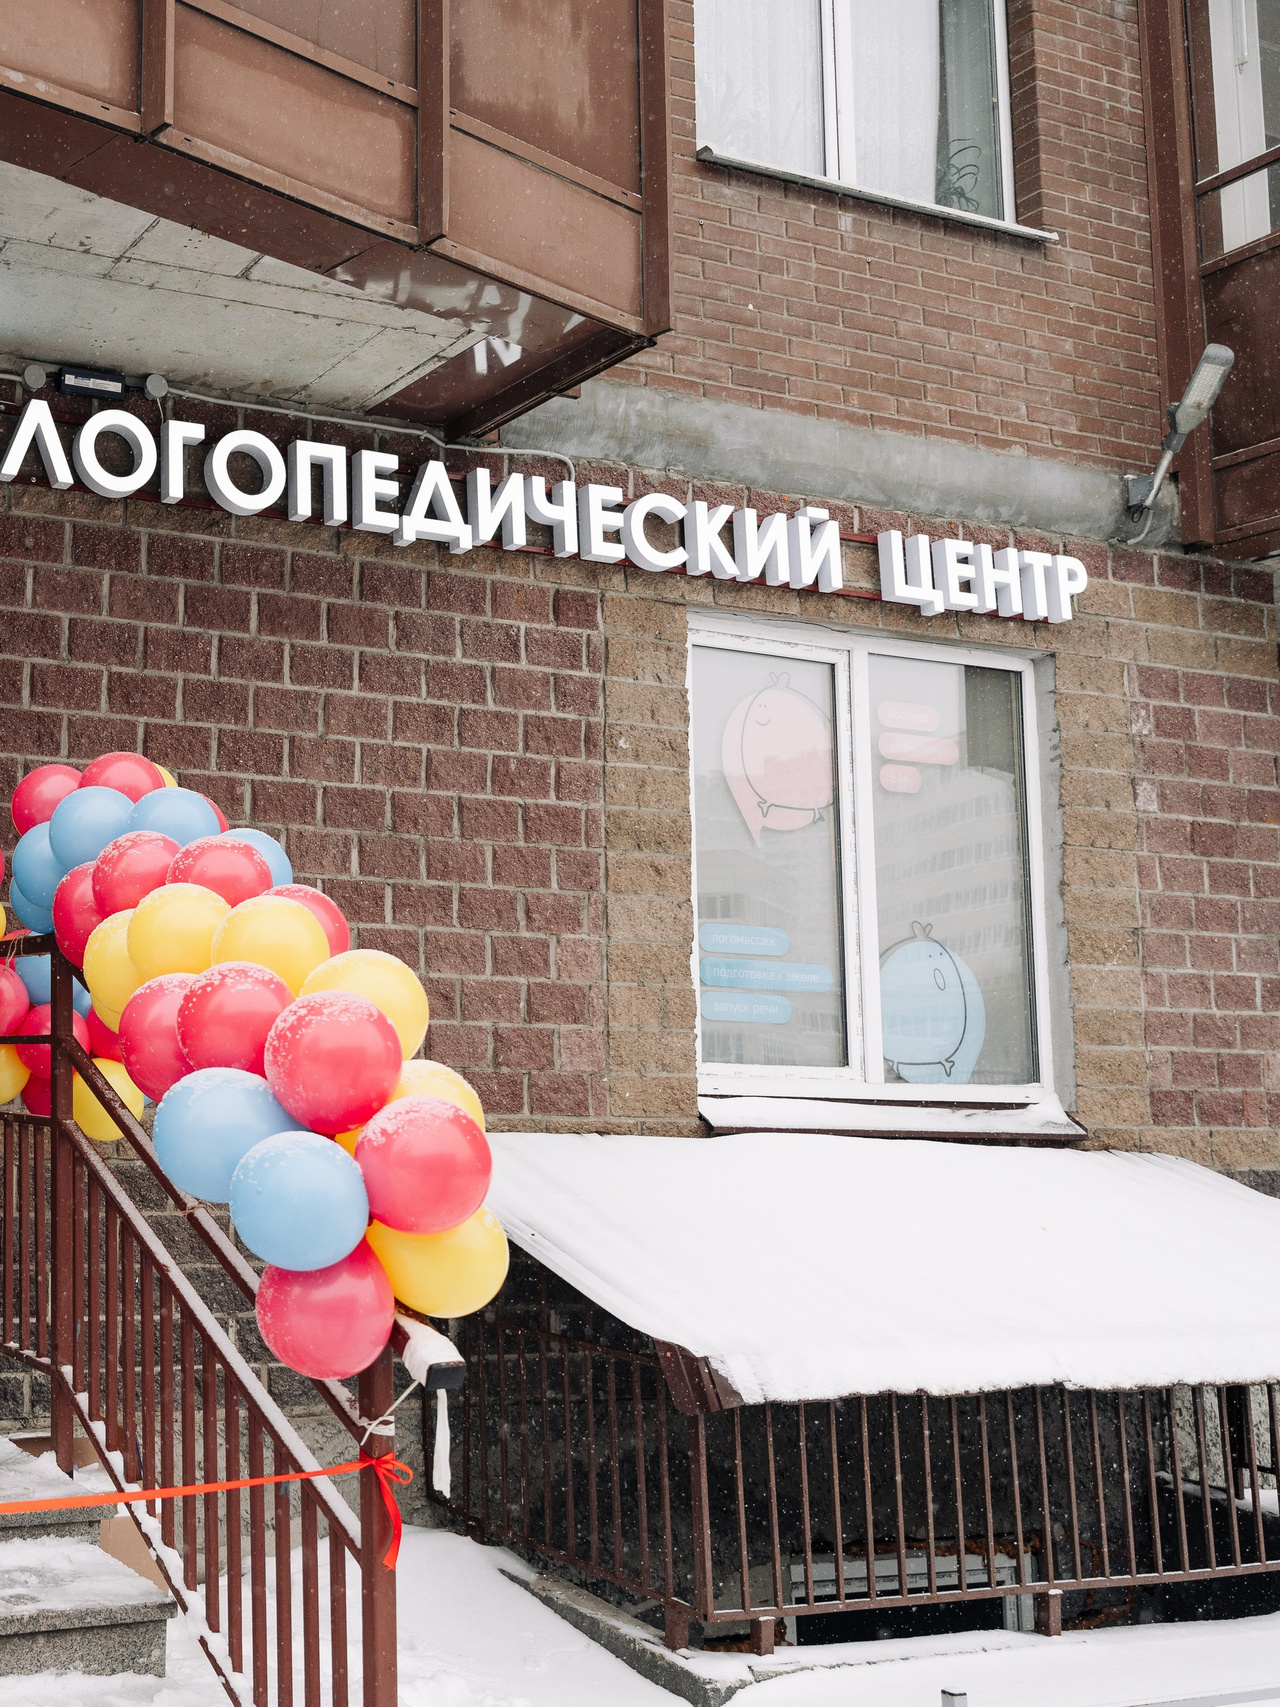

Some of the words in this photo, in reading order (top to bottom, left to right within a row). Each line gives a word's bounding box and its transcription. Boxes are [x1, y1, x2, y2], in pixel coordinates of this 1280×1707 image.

[878, 529, 1088, 624] ЦЕНТР
[887, 711, 929, 724] логопед
[889, 742, 949, 757] дефектолог
[891, 772, 911, 784] БАК
[711, 934, 777, 947] логомассаж
[713, 968, 775, 980] подготовка
[786, 972, 820, 983] школе
[713, 1002, 750, 1014] запуск
[752, 1004, 778, 1015] речи
